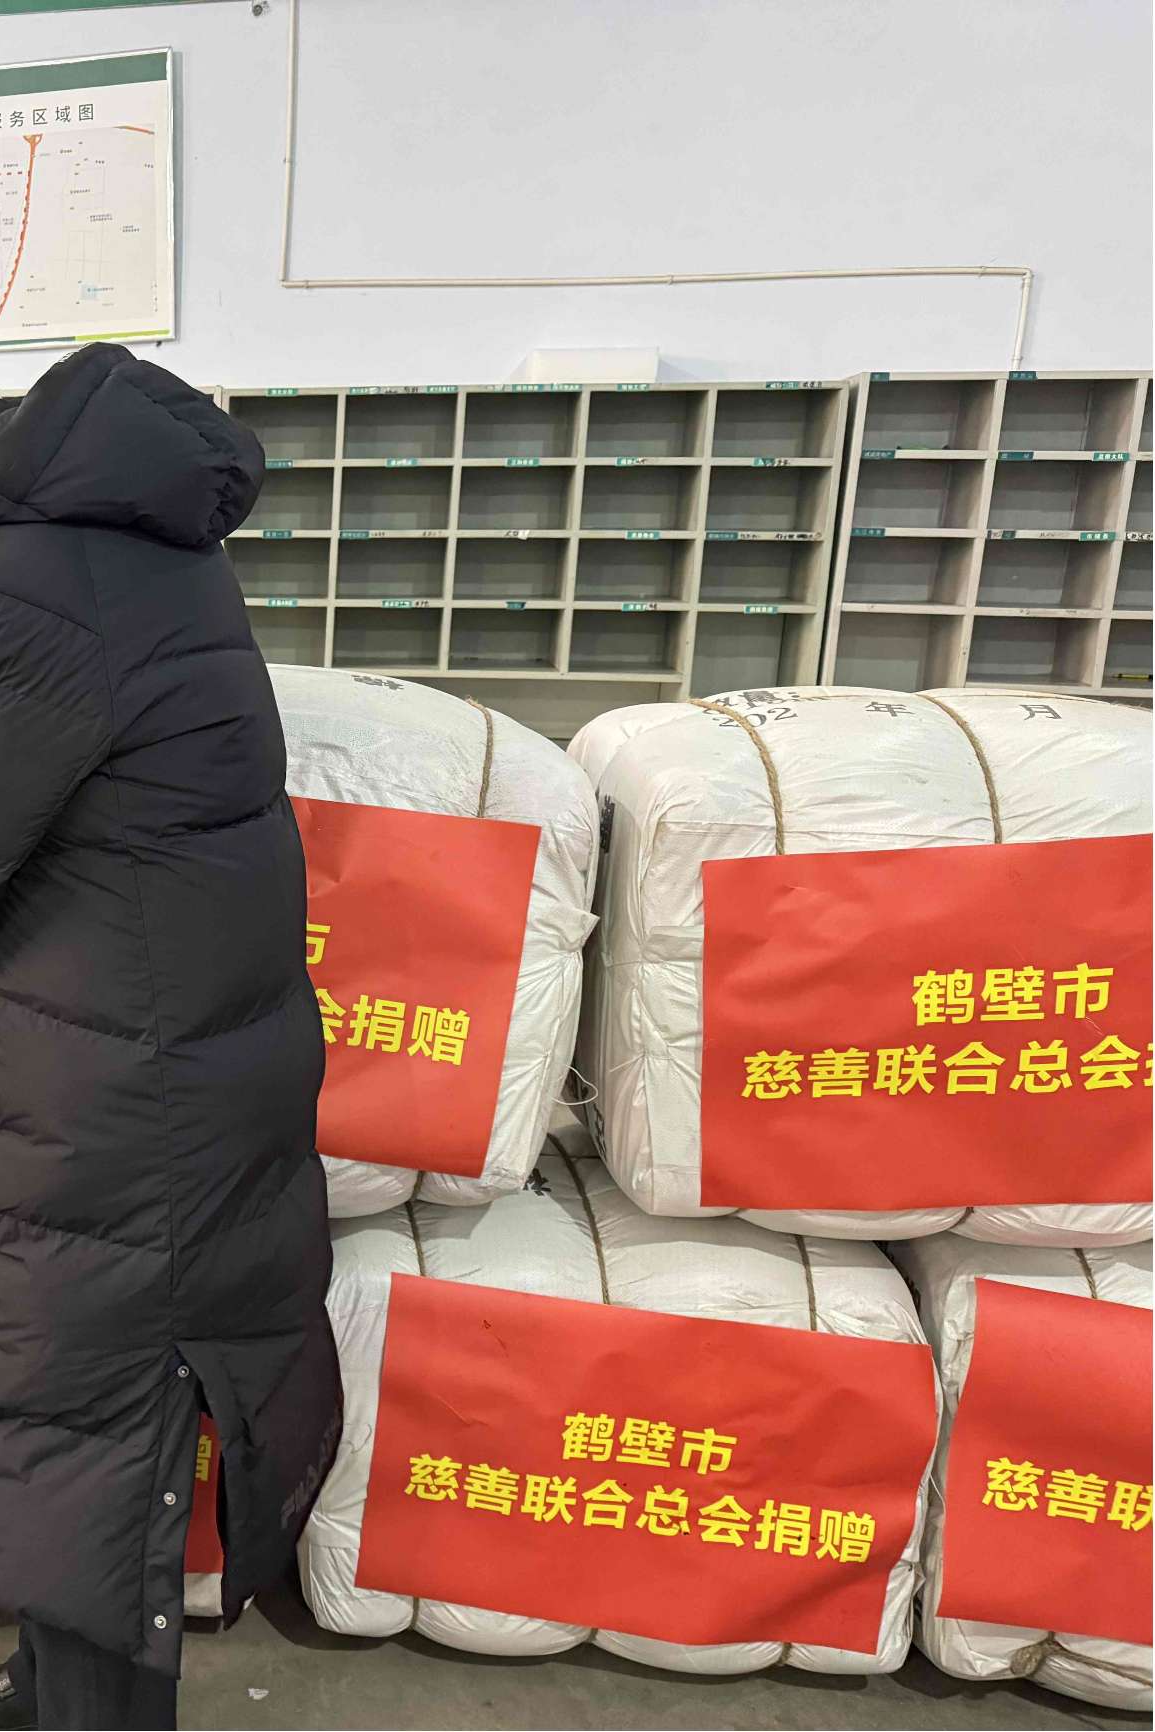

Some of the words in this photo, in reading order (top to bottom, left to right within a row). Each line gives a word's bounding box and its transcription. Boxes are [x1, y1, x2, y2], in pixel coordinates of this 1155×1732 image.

[865, 701, 915, 717] 年
[1017, 704, 1060, 720] 月
[912, 962, 1115, 1027] 鹤壁市
[741, 1034, 1153, 1100] 慈善联合总会
[561, 1412, 738, 1475] 鹤壁市
[404, 1453, 877, 1564] 慈善联合总会捐赠
